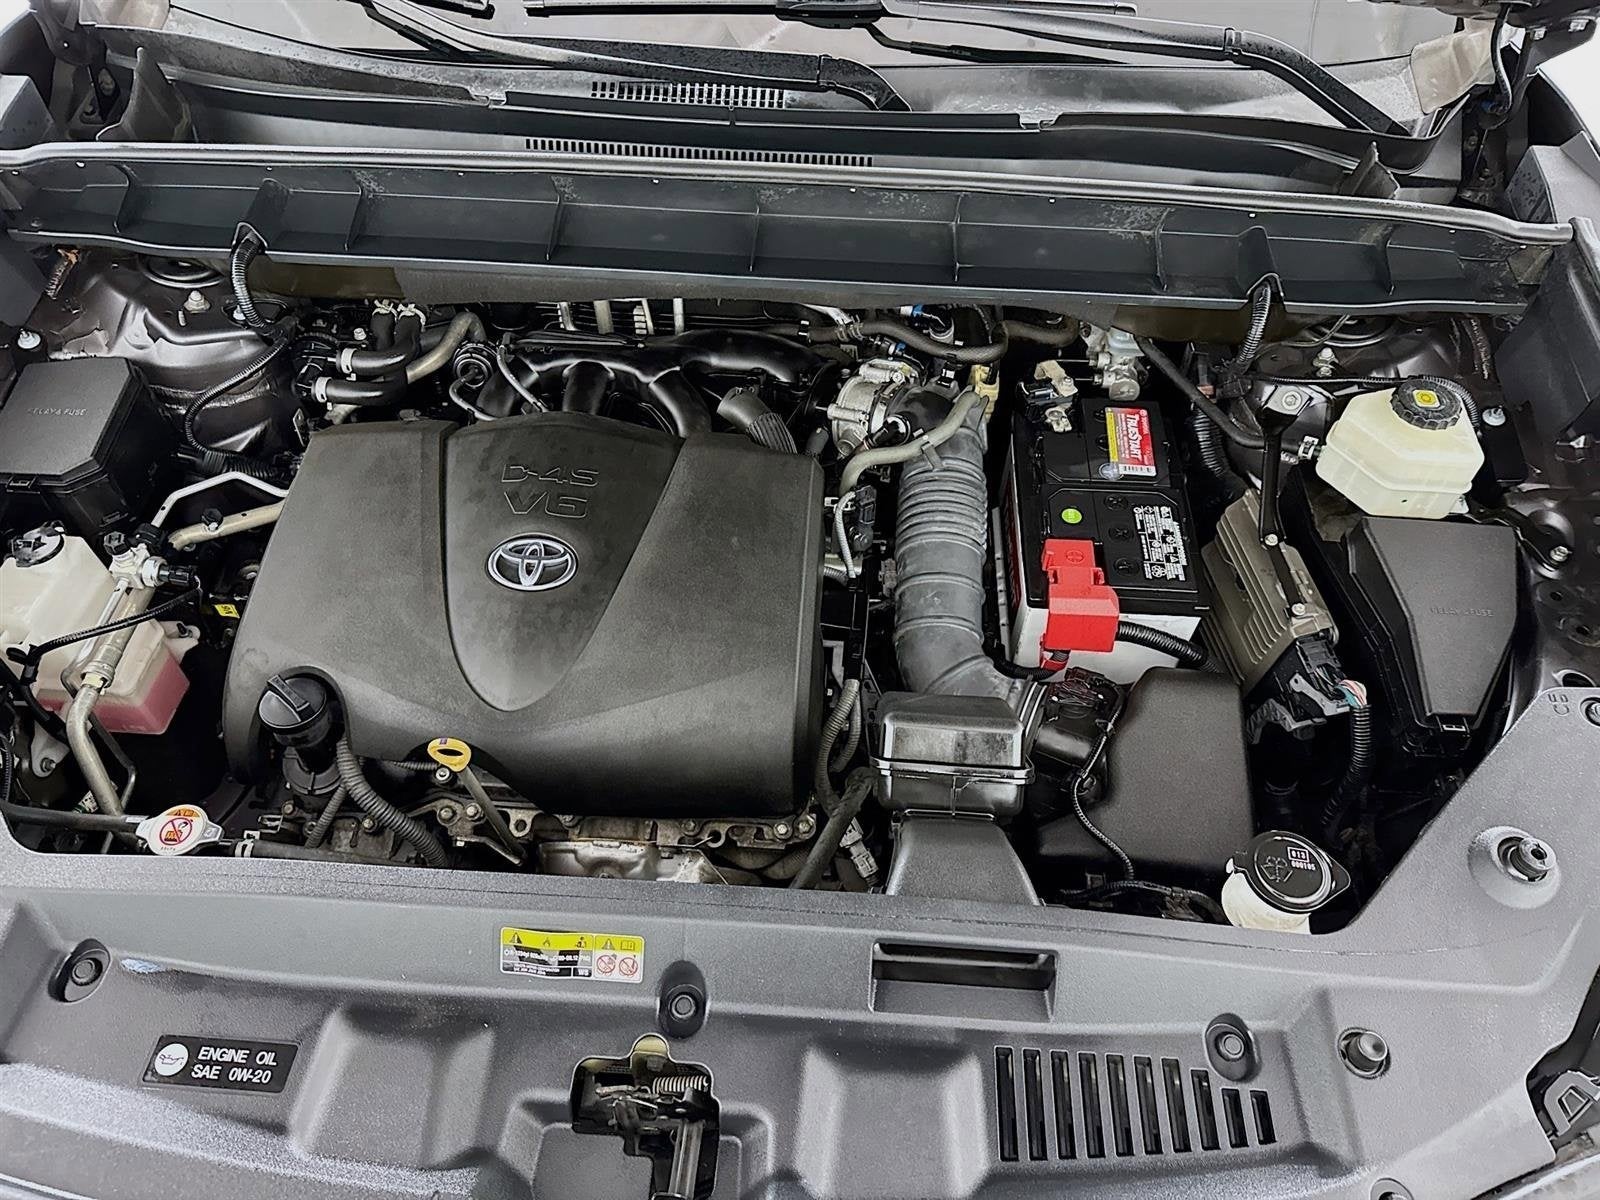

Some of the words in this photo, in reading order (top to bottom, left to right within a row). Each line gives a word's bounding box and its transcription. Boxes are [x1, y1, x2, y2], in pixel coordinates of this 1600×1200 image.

[501, 464, 599, 487] D-4S
[503, 491, 587, 518] V6
[198, 1047, 249, 1063] ENGINE
[255, 1051, 277, 1066] OIL
[191, 1064, 221, 1079] SAE
[228, 1067, 272, 1083] 0W-20
